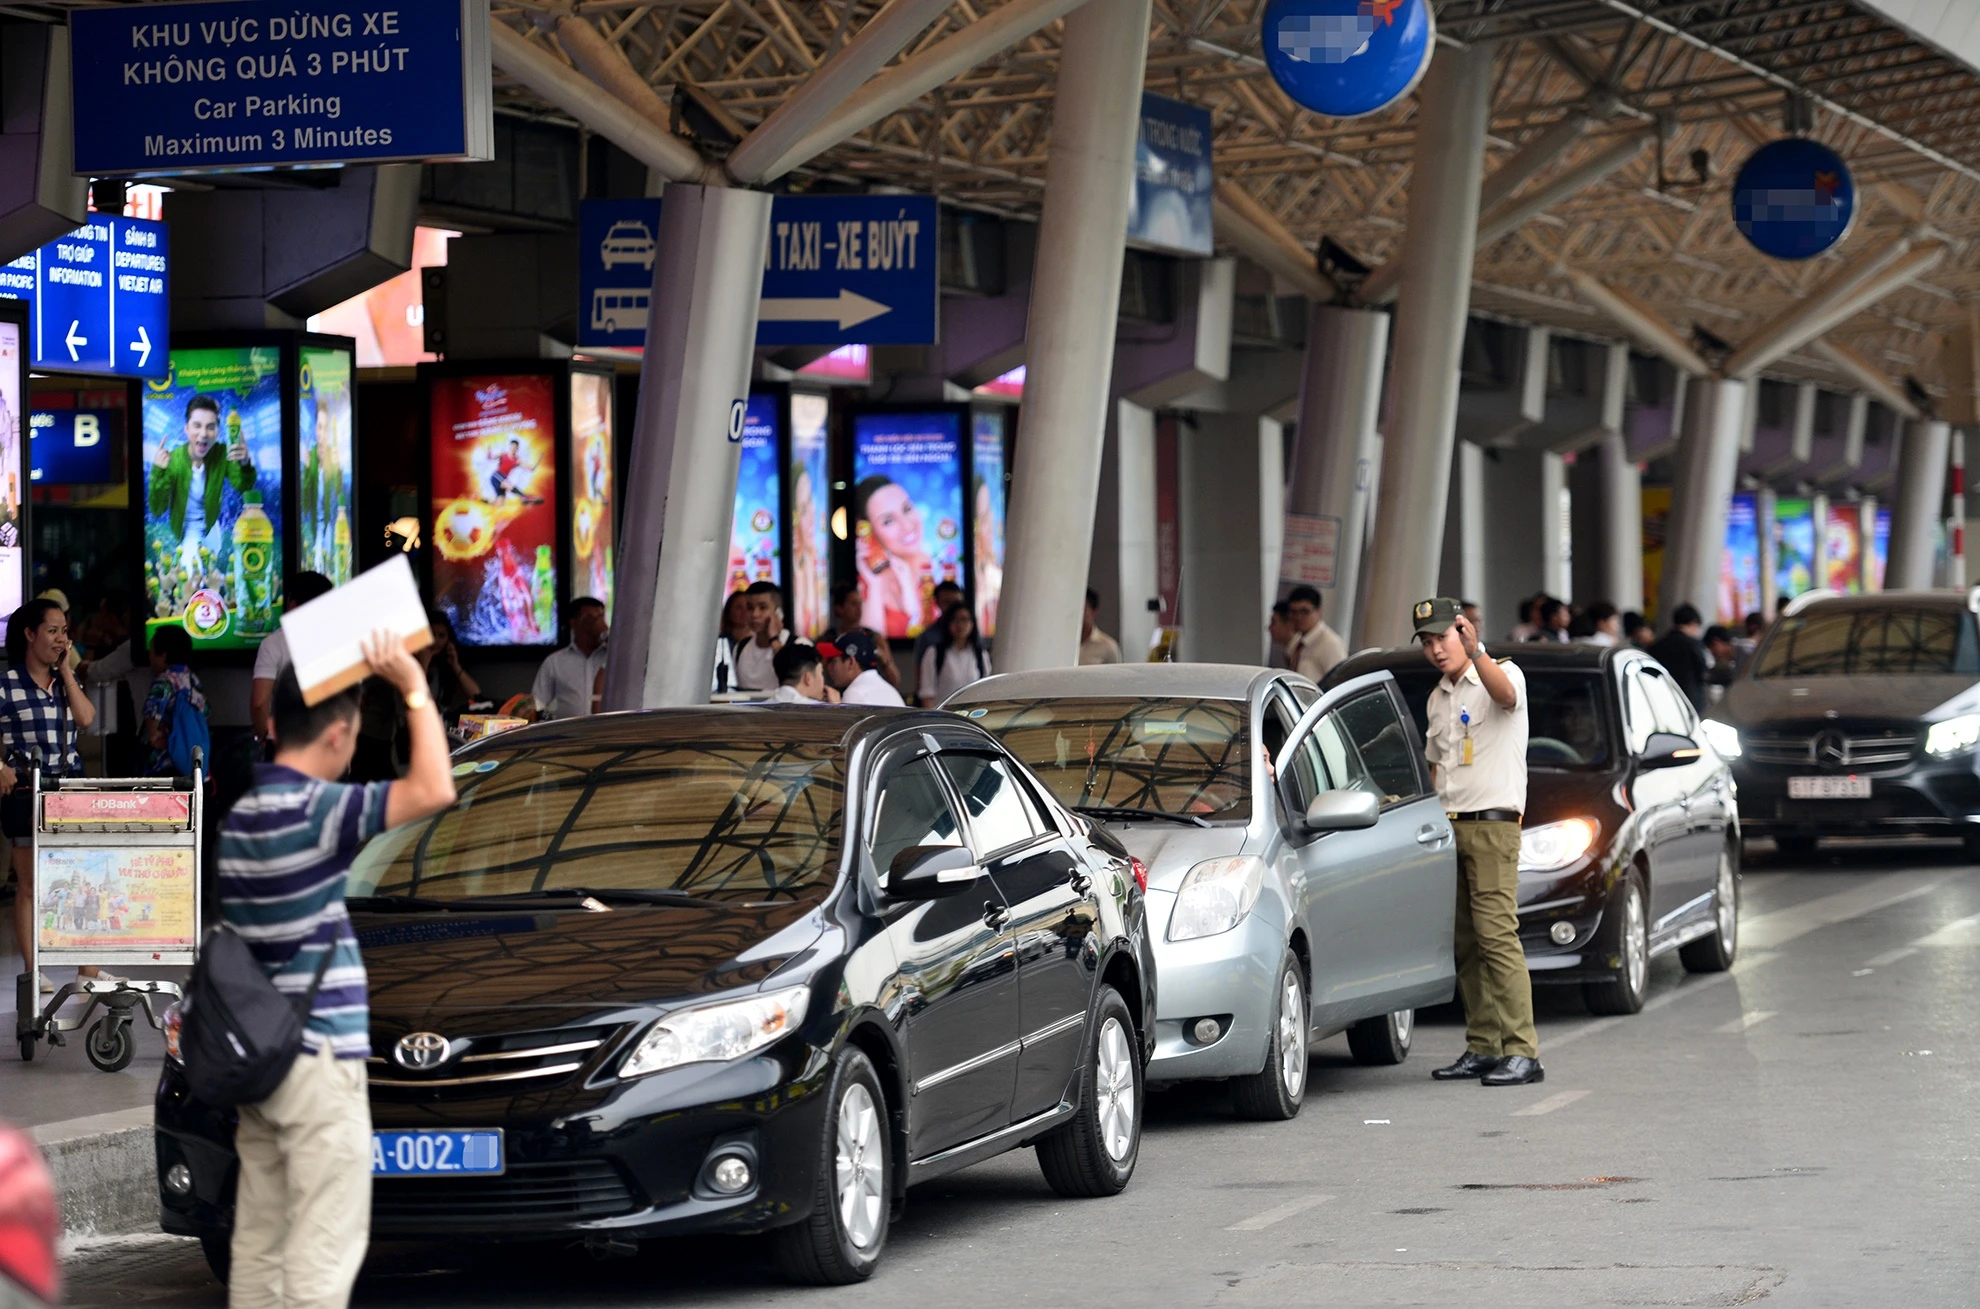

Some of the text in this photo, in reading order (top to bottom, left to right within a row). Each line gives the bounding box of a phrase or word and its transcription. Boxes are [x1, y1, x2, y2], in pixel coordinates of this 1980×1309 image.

[132, 10, 400, 48] KHU VỰC DỪNG XE
[124, 42, 410, 85] KHÔNG QUÁ 3 PHÚT
[194, 93, 342, 119] Car Parking
[144, 126, 393, 156] Maximum 3 Minutes
[867, 208, 920, 270] BUÝT
[115, 251, 166, 272] DEPARTURES
[49, 267, 103, 287] INFORMATION
[118, 274, 164, 294] VIETJET AIR
[74, 414, 100, 447] B
[92, 799, 137, 809] HDBank
[371, 1135, 497, 1170] A-002.
